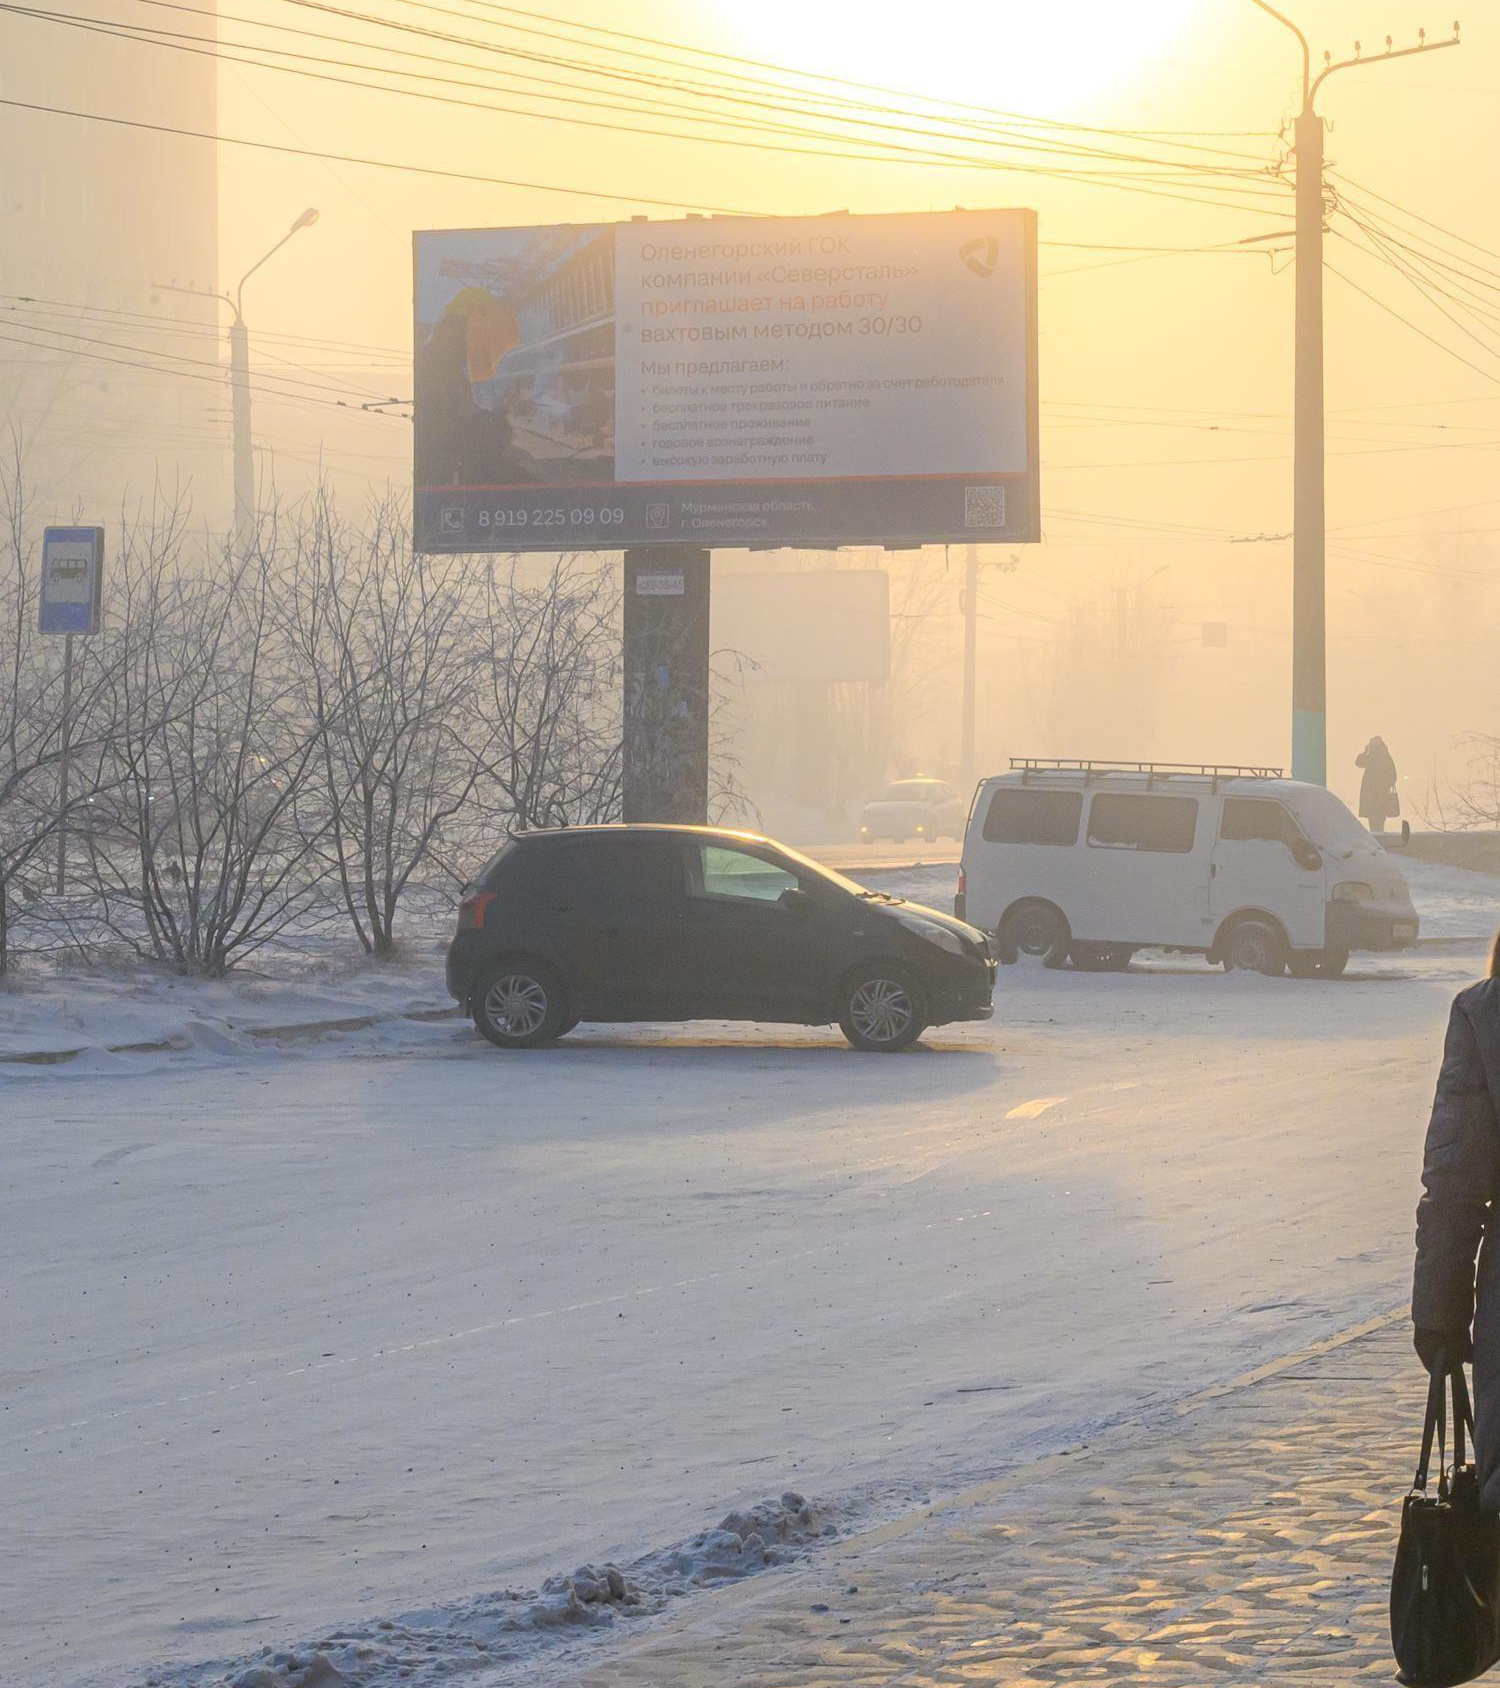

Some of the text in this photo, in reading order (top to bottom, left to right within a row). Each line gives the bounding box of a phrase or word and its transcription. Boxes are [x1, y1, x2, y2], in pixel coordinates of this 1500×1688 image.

[641, 236, 851, 262] Оленегорский ГОК
[641, 264, 920, 289] компании «Северсталь»
[641, 291, 888, 318] приглашает на работу
[641, 316, 922, 343] вахтовым методом 30/30
[641, 359, 789, 377] Мы предлагаем:
[750, 381, 797, 395] работы
[811, 378, 864, 392] обратно
[914, 376, 1005, 389] работодателя
[653, 401, 727, 413] бесплатное
[816, 397, 870, 409] питание
[653, 417, 811, 431] бесплатное проживание
[653, 434, 814, 449] годовое вознаграждение
[653, 451, 827, 467] высокую заработную плату
[478, 507, 624, 527] 8 919 225 09 09
[681, 502, 760, 515] Мурманская
[692, 517, 768, 529] Оленегорск
